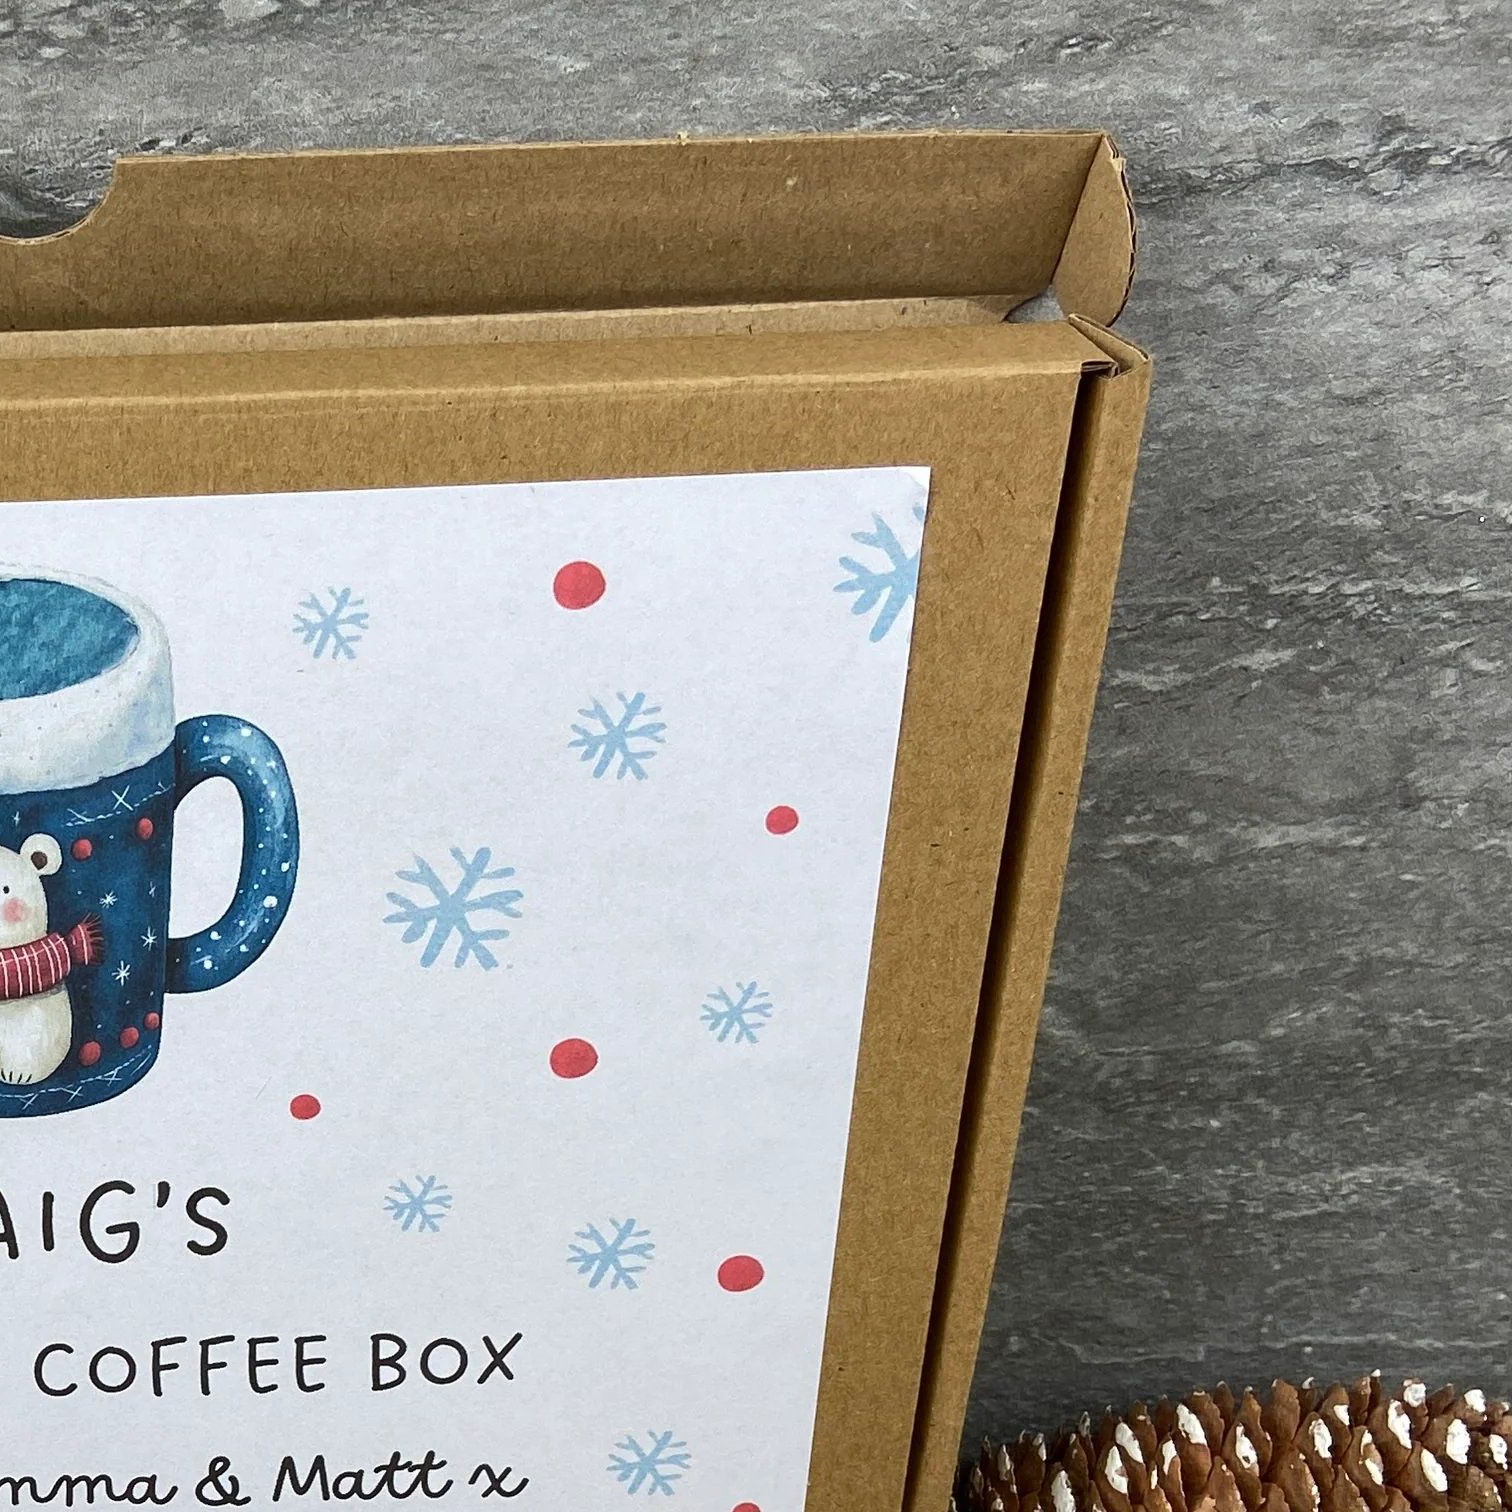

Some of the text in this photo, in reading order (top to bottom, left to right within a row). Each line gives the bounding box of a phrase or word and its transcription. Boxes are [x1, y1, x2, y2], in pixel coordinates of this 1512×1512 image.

[33, 1334, 327, 1397] COFFEE
[370, 1332, 523, 1392] BOX
[195, 1455, 252, 1507] &
[272, 1450, 454, 1502] Matt
[468, 1463, 530, 1499] x
